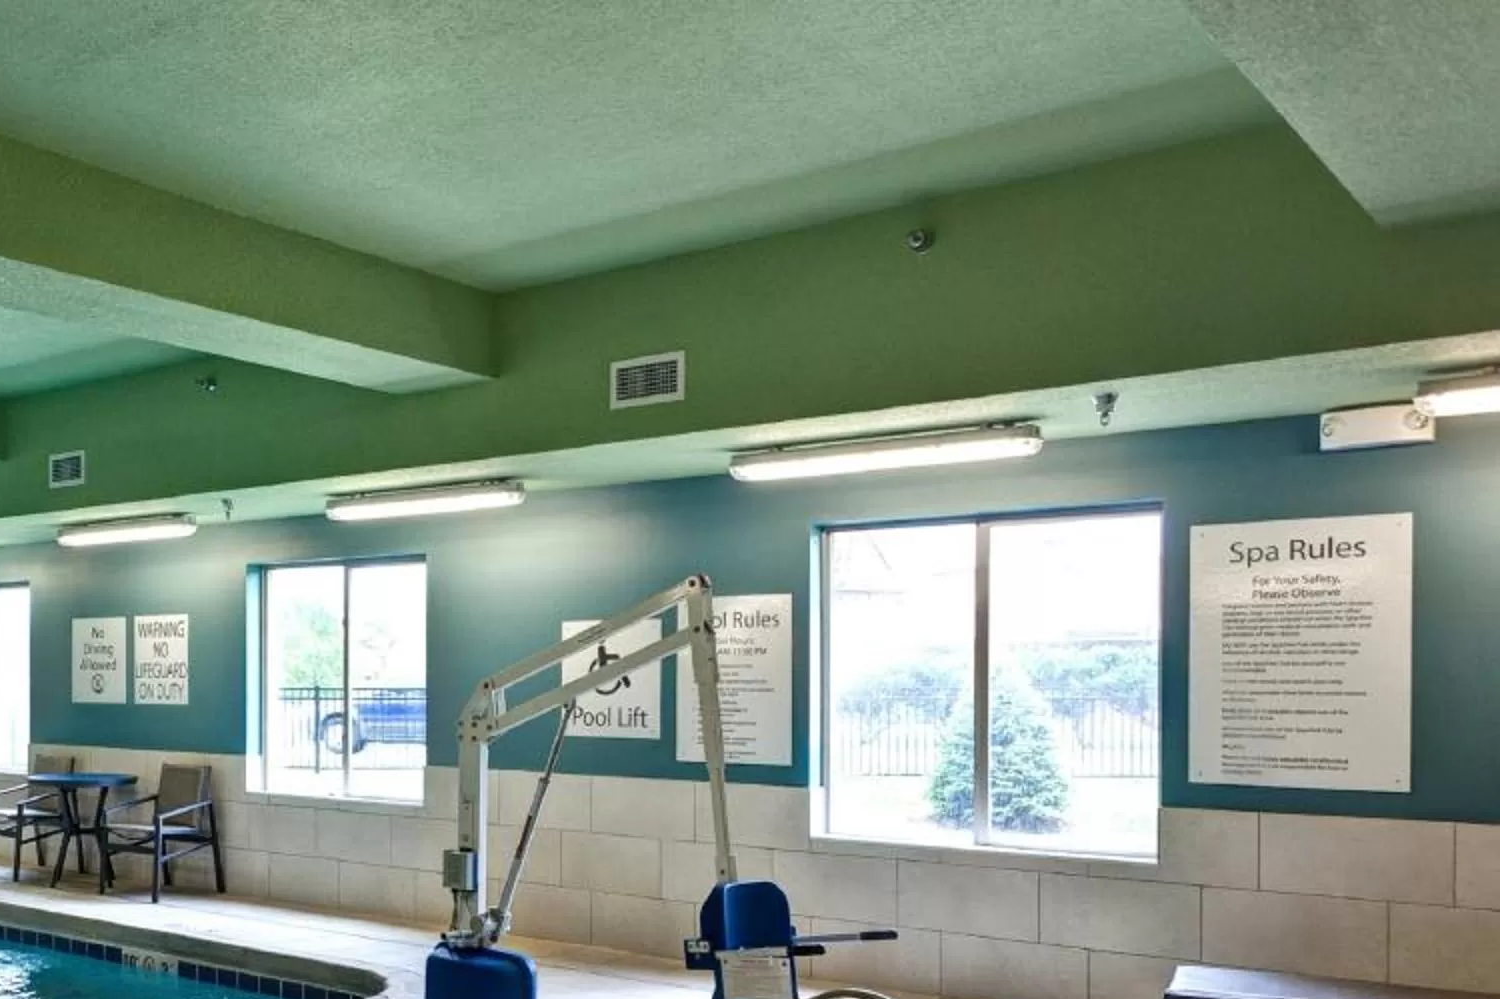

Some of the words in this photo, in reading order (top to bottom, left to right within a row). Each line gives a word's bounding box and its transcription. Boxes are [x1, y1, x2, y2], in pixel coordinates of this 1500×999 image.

[1229, 541, 1280, 568] Spa
[1289, 536, 1367, 561] Rules
[1291, 588, 1341, 599] Observe
[712, 612, 727, 629] ol
[733, 611, 780, 629] Rules
[138, 620, 185, 638] WARNING
[84, 643, 115, 658] Diving
[153, 641, 169, 658] NO
[80, 659, 117, 671] Allowed
[135, 662, 186, 679] LIFEGUARD
[139, 682, 154, 700] ON
[157, 682, 185, 701] DUTY
[572, 707, 611, 727] Pool
[618, 706, 649, 728] Lift
